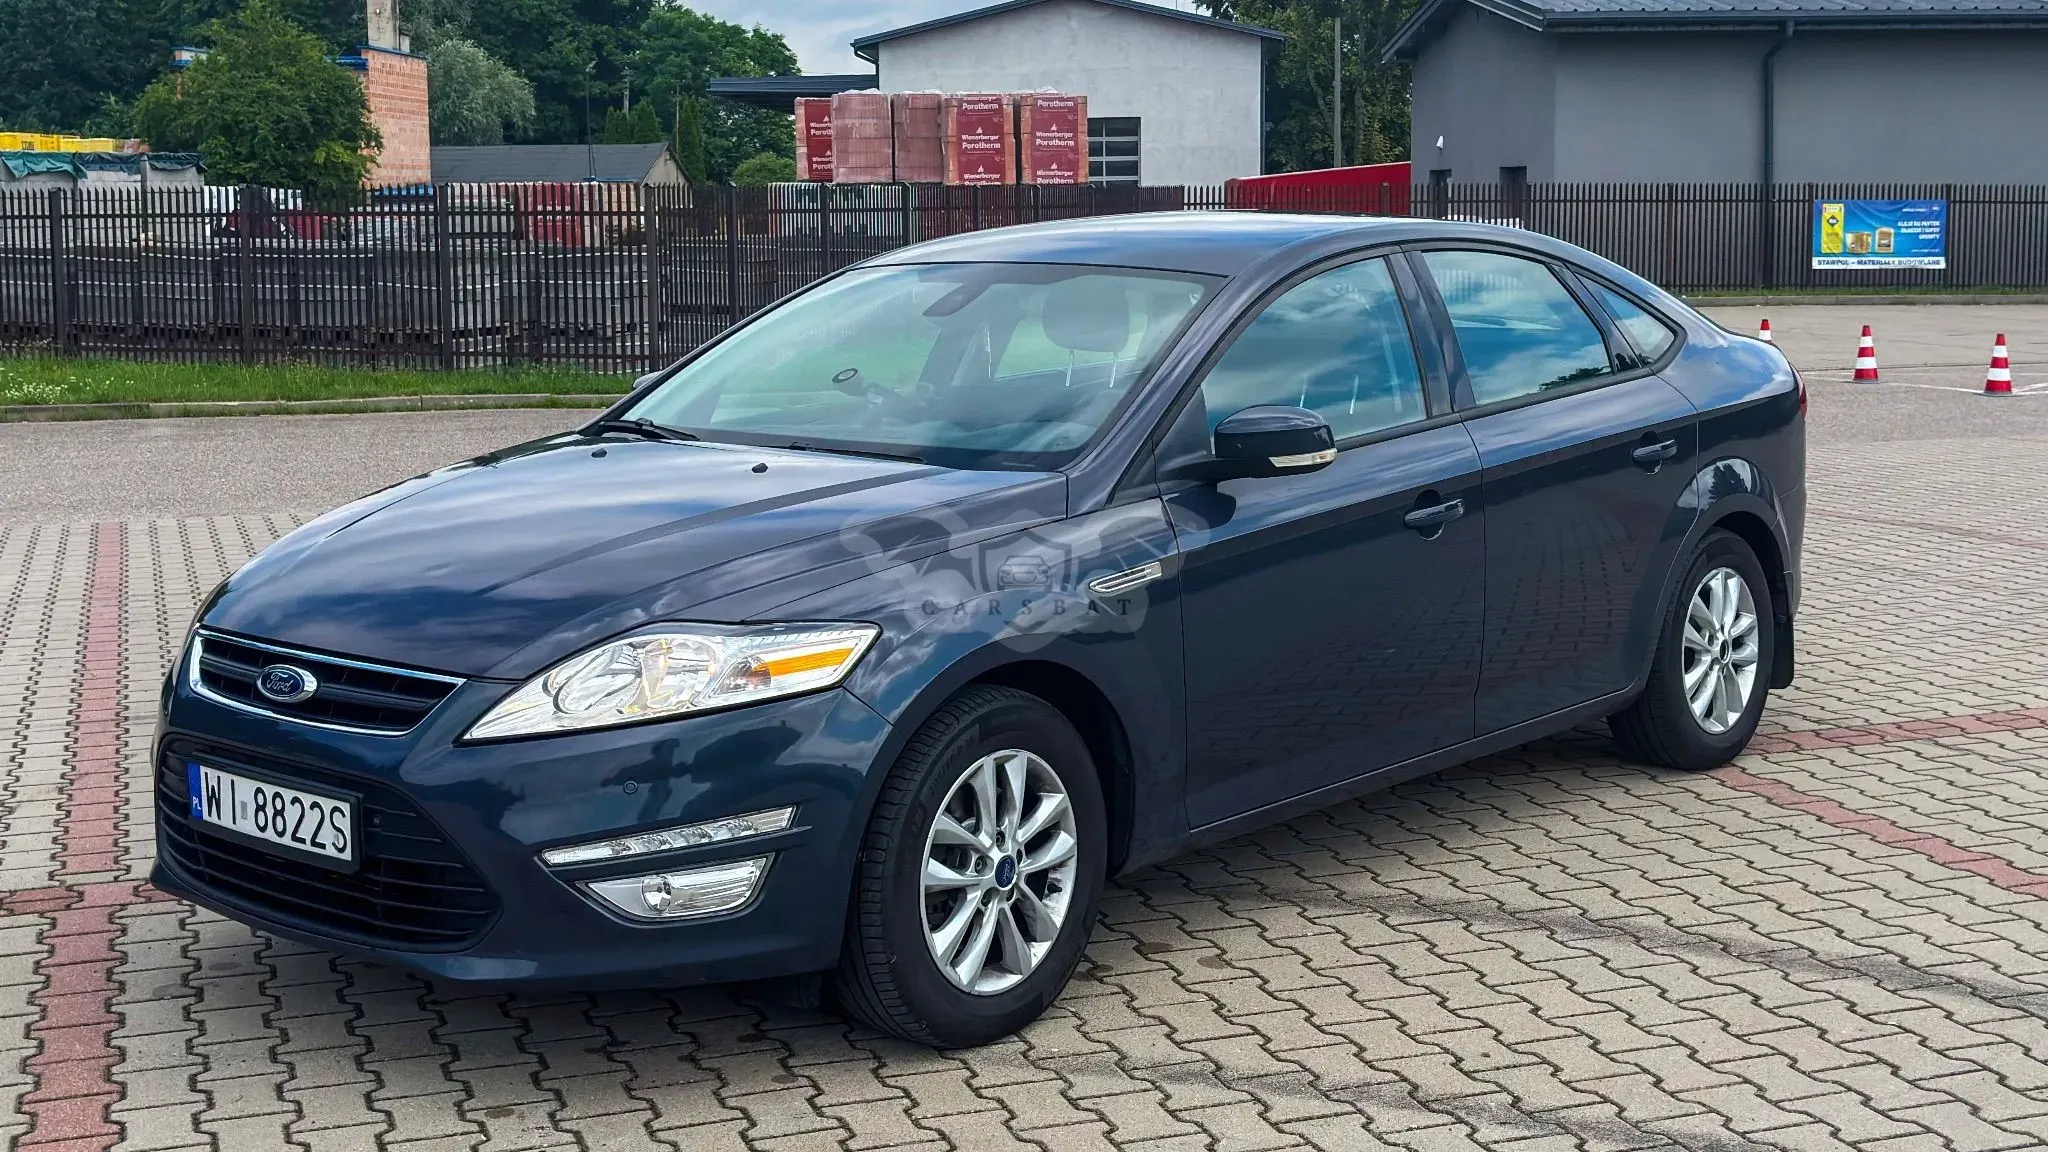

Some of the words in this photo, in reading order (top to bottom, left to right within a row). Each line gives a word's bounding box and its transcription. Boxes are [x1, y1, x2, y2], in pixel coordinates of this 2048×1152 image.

[962, 102, 999, 110] Porotherm
[1037, 99, 1074, 107] Porotherm
[1035, 131, 1074, 139] Wienerberger
[962, 141, 1001, 149] Porotherm
[1035, 138, 1075, 147] Porotherm
[266, 671, 294, 693] Ford
[192, 796, 202, 811] PL
